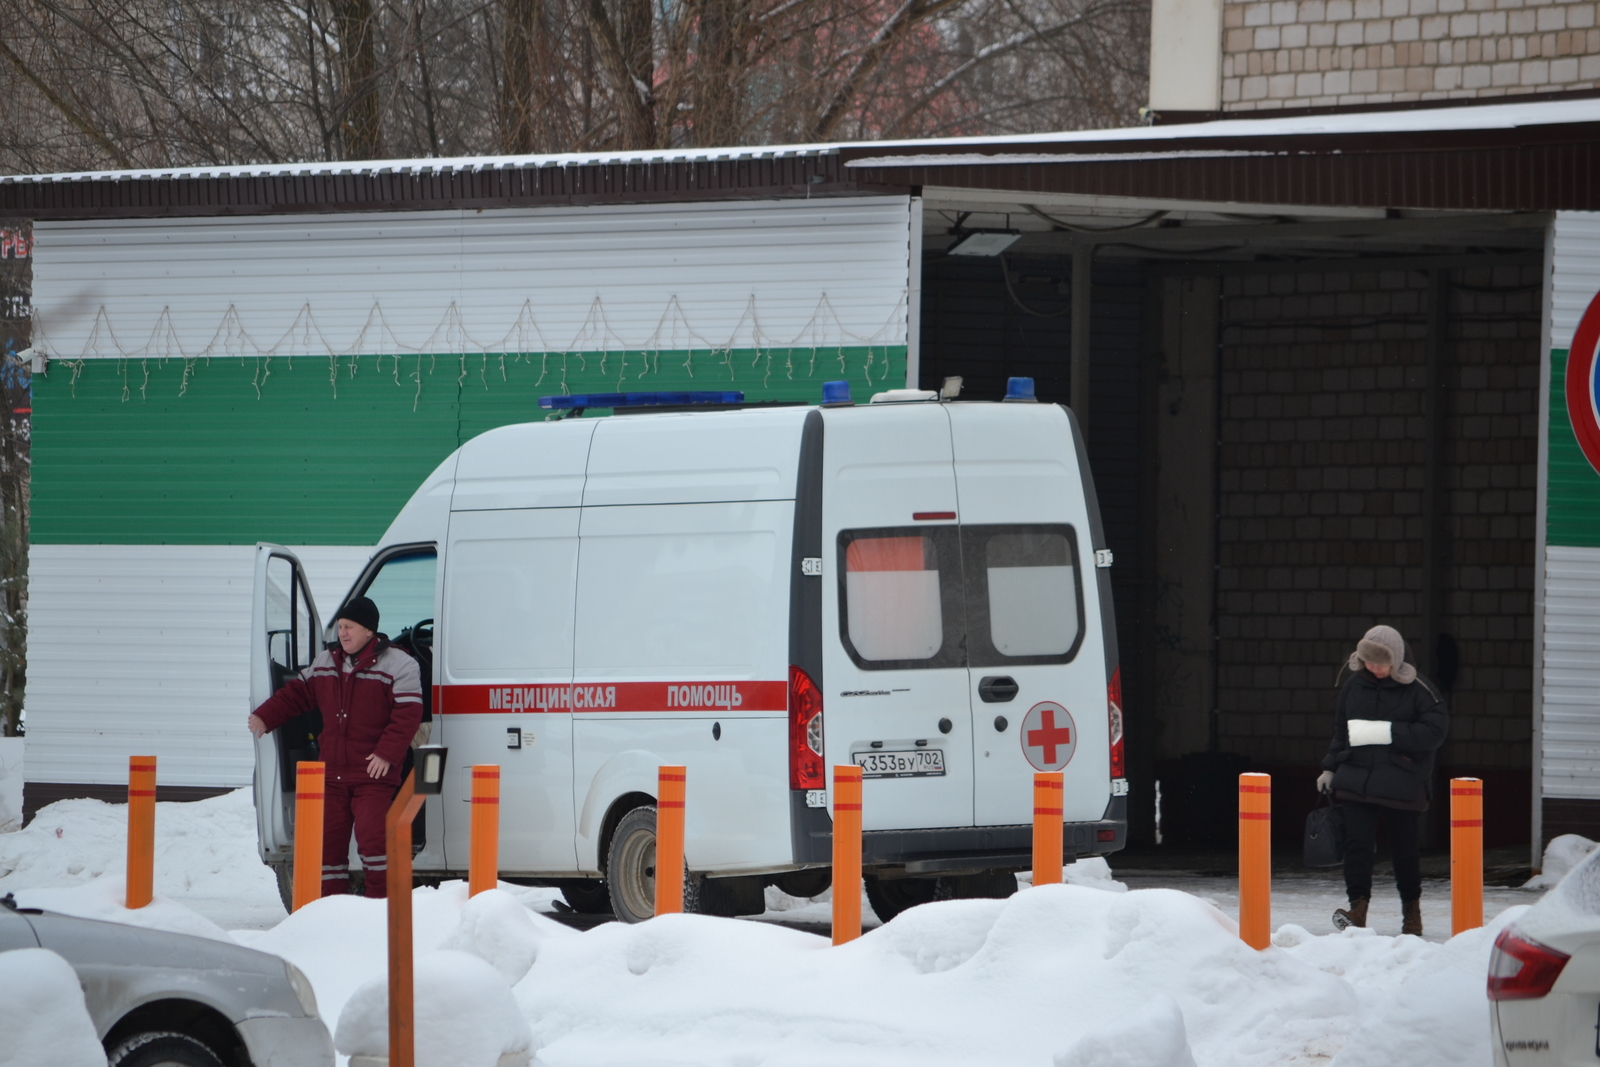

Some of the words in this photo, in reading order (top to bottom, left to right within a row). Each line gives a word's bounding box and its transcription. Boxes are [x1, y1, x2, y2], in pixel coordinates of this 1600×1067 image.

[489, 686, 616, 712] МЕДИЦИНСКАЯ
[667, 685, 742, 710] ПОМОЩЬ
[917, 753, 939, 765] 702
